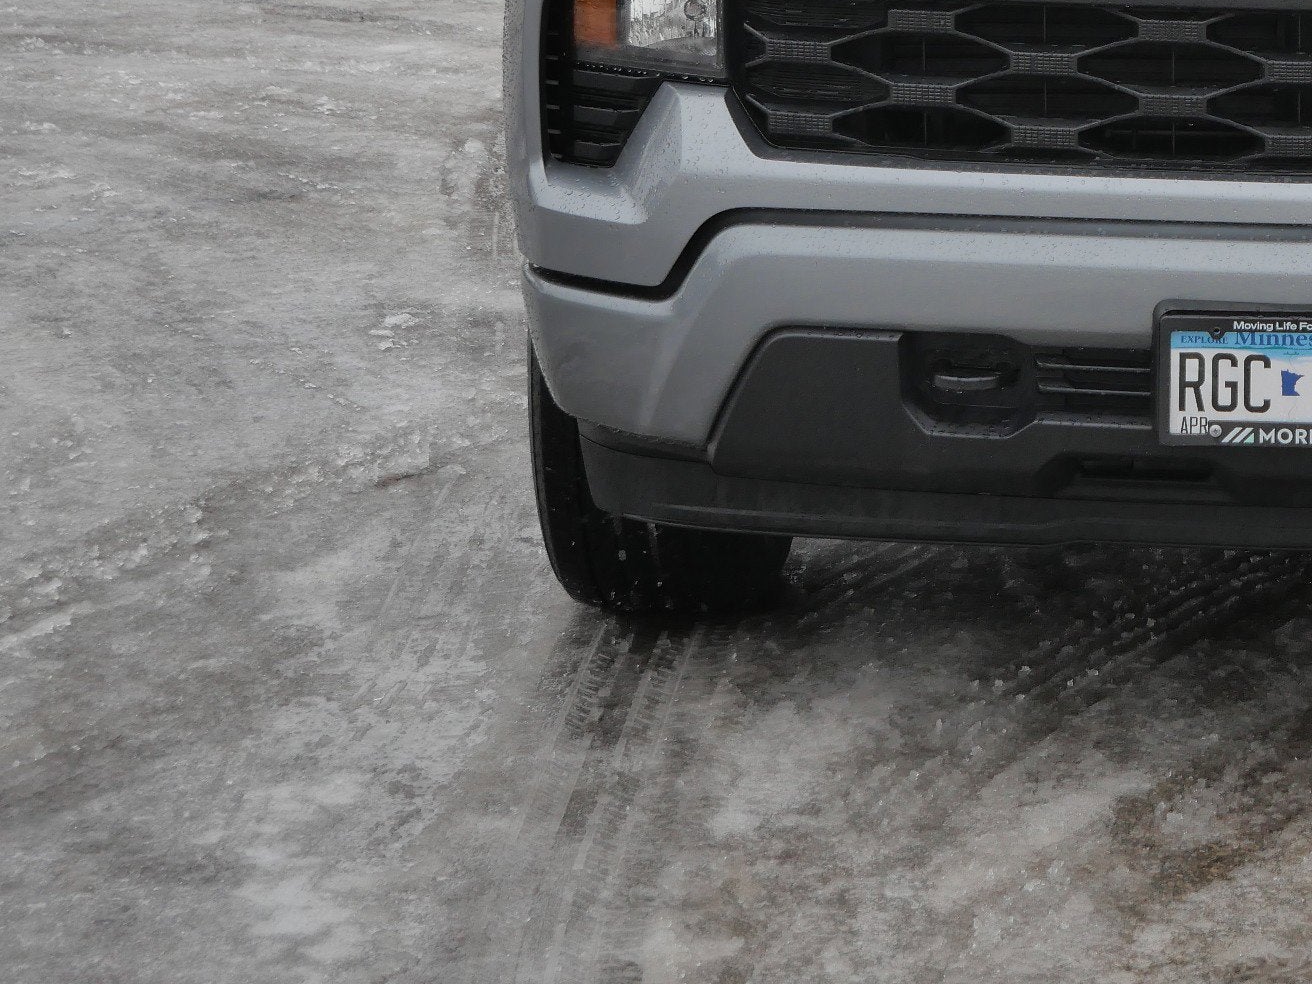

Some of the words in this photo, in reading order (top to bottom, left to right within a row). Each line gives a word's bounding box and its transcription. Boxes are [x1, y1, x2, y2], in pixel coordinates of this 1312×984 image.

[1233, 320, 1274, 332] Moving
[1276, 321, 1298, 331] Life
[1178, 352, 1272, 413] RGC
[1180, 416, 1208, 435] APR
